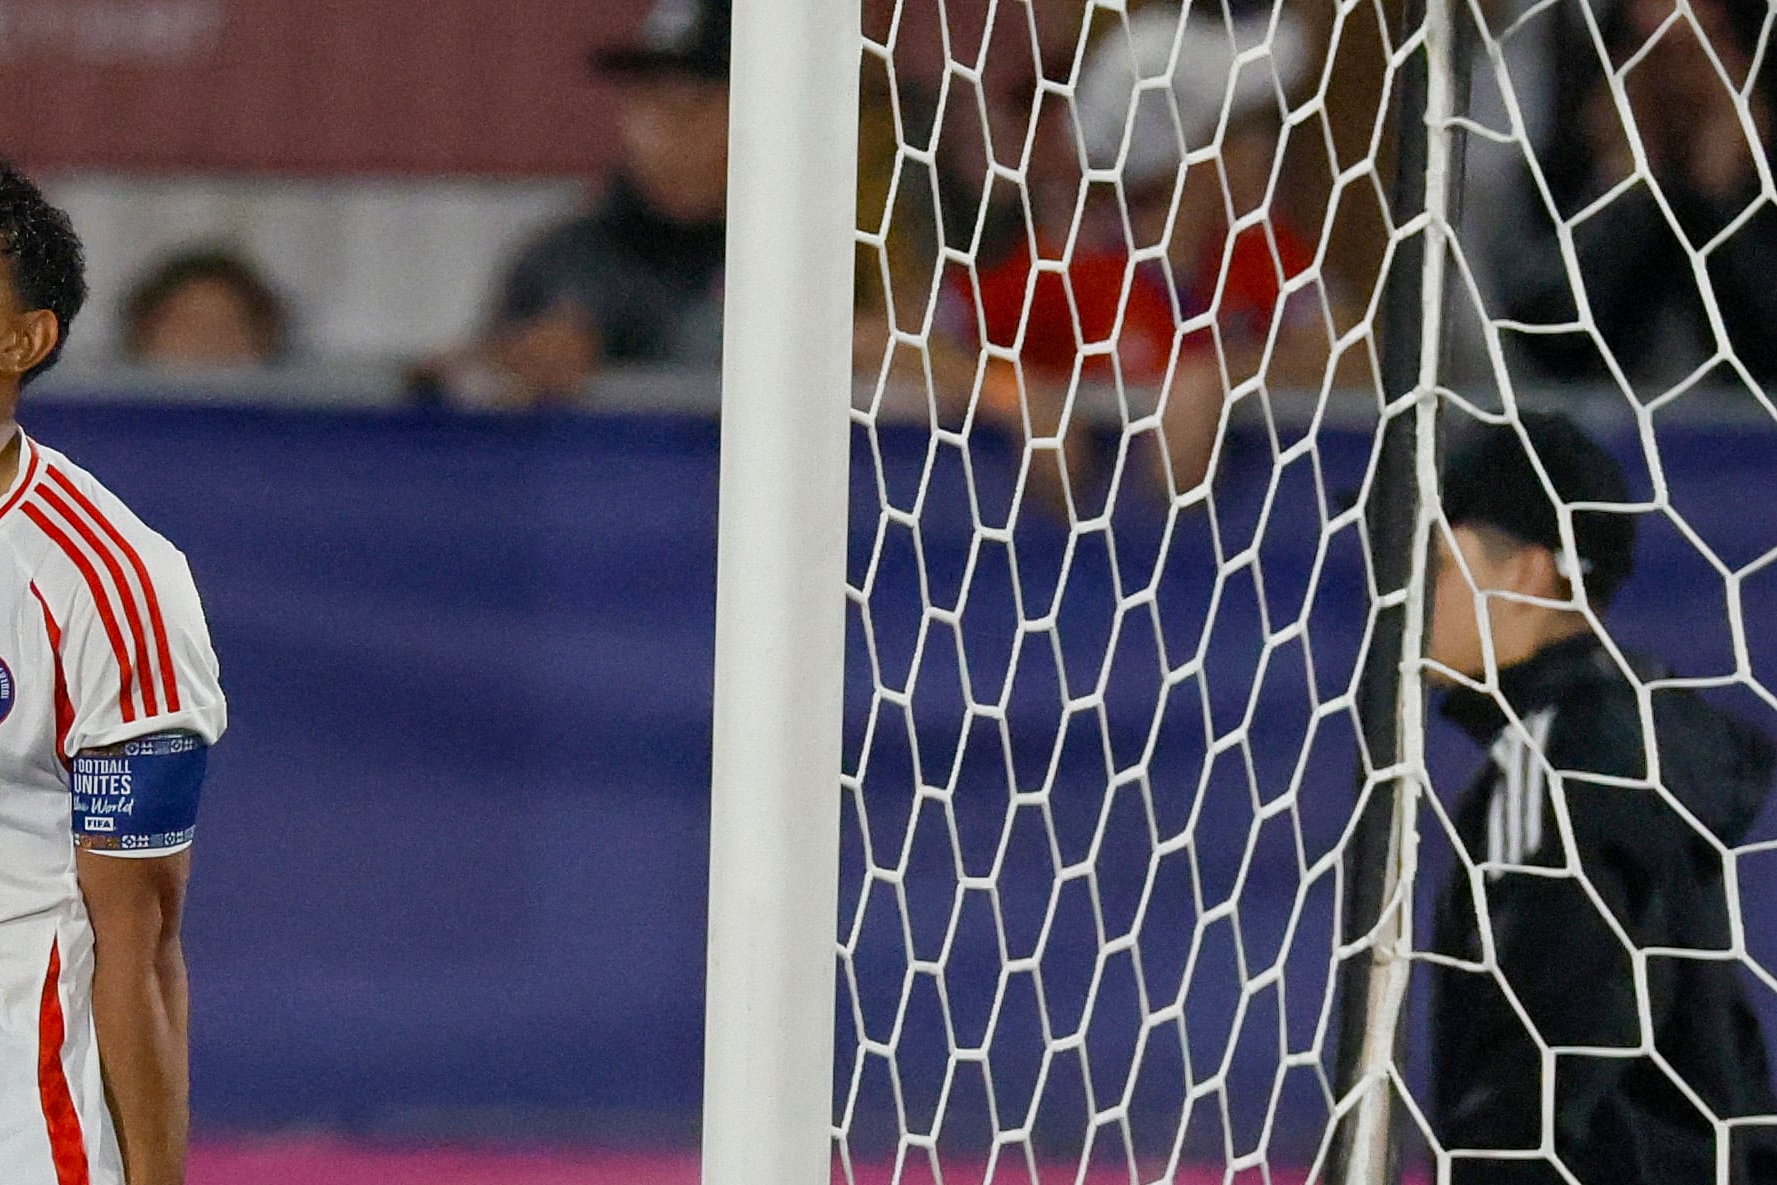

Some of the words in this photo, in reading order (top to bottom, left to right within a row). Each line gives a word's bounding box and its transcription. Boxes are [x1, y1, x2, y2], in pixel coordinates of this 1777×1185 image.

[73, 774, 132, 795] UNITES
[91, 796, 135, 816] World
[87, 819, 111, 828] FIFA
